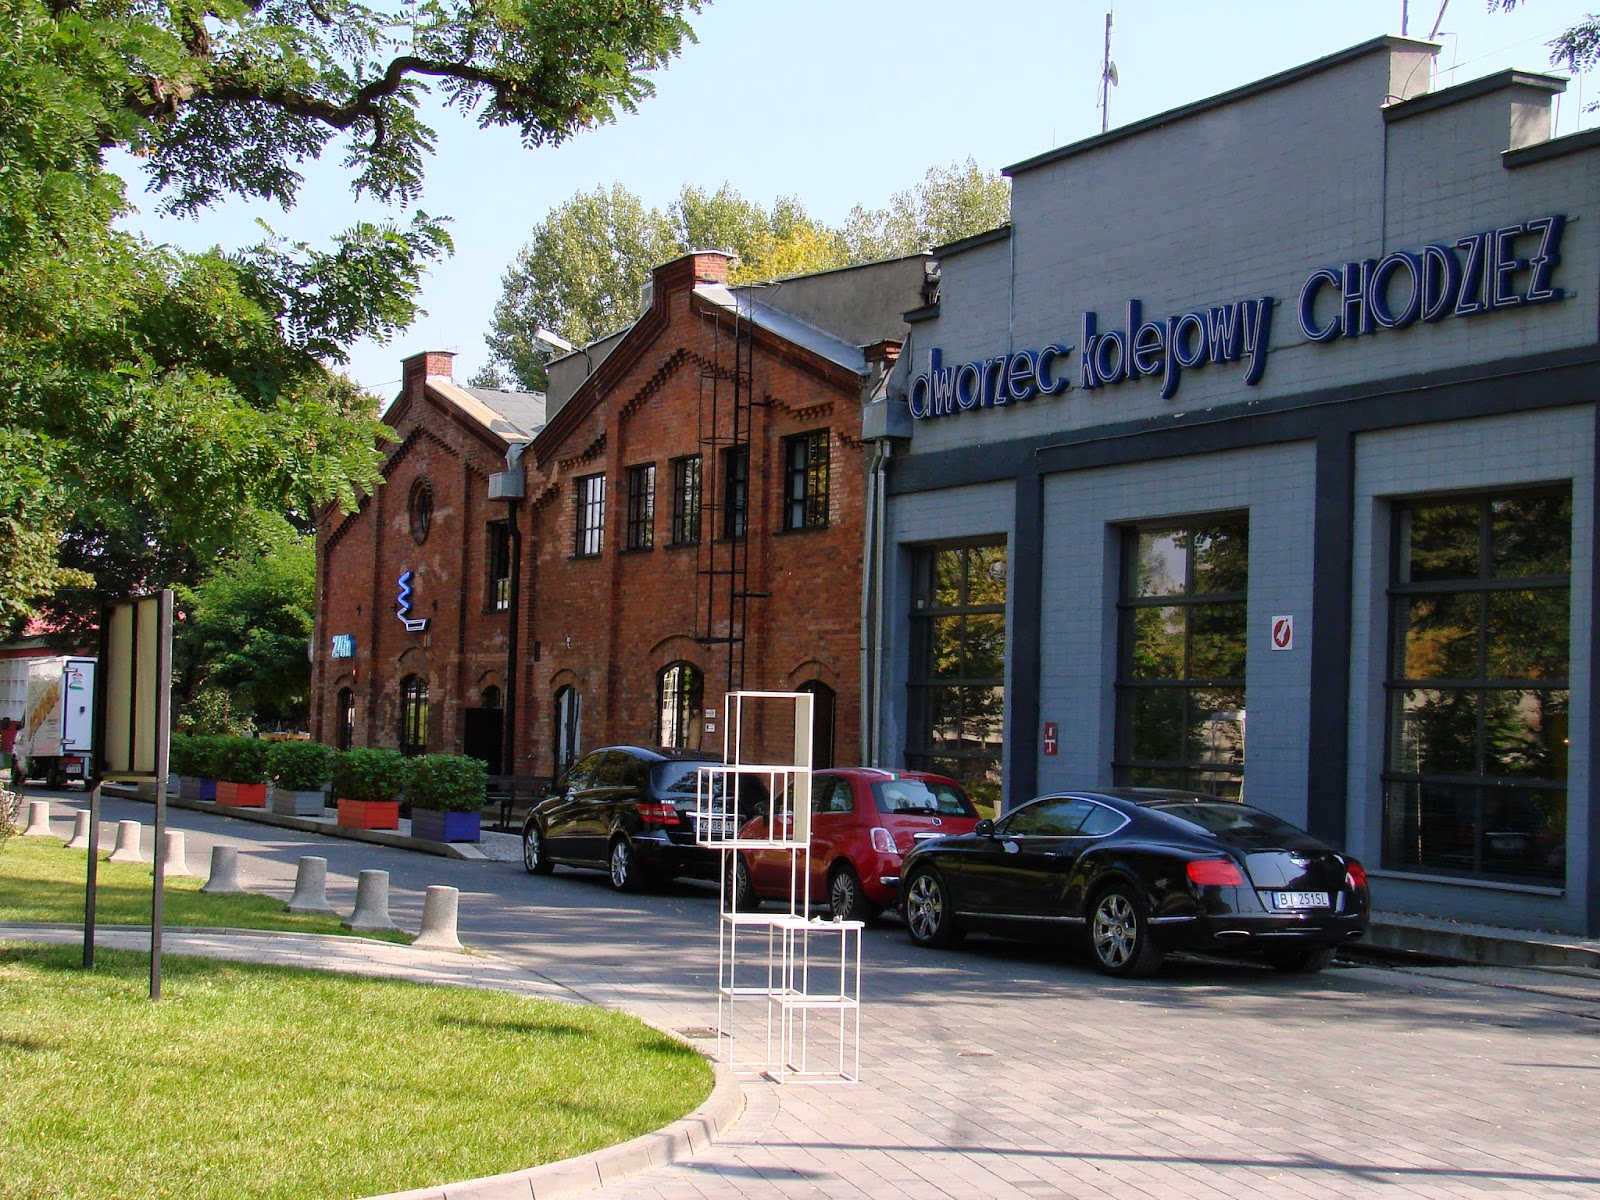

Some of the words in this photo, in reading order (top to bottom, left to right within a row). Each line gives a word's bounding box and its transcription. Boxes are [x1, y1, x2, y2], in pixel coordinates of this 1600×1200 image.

[908, 343, 1071, 420] dworzec
[1081, 296, 1275, 400] kolejowy
[331, 634, 354, 658] 24h
[1280, 893, 1294, 905] BI
[1299, 893, 1328, 905] 2515L
